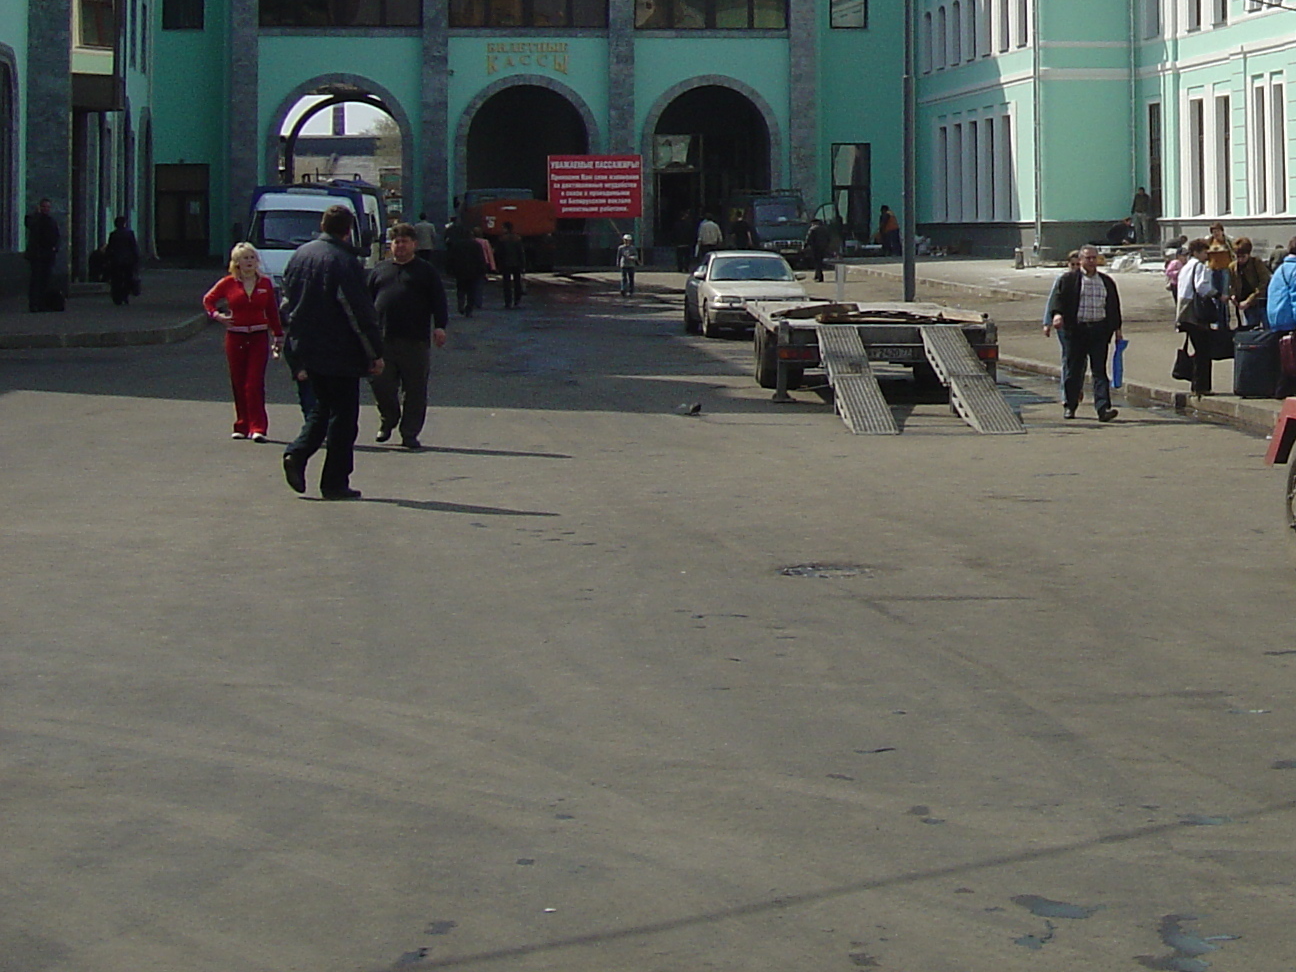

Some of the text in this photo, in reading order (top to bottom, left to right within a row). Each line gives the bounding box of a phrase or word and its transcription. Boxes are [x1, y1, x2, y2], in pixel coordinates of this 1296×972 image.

[487, 42, 568, 53] БИЛЕТНЫЕ
[487, 55, 569, 75] КАССЫ
[551, 160, 594, 169] УВАЖАЕМЫЕ
